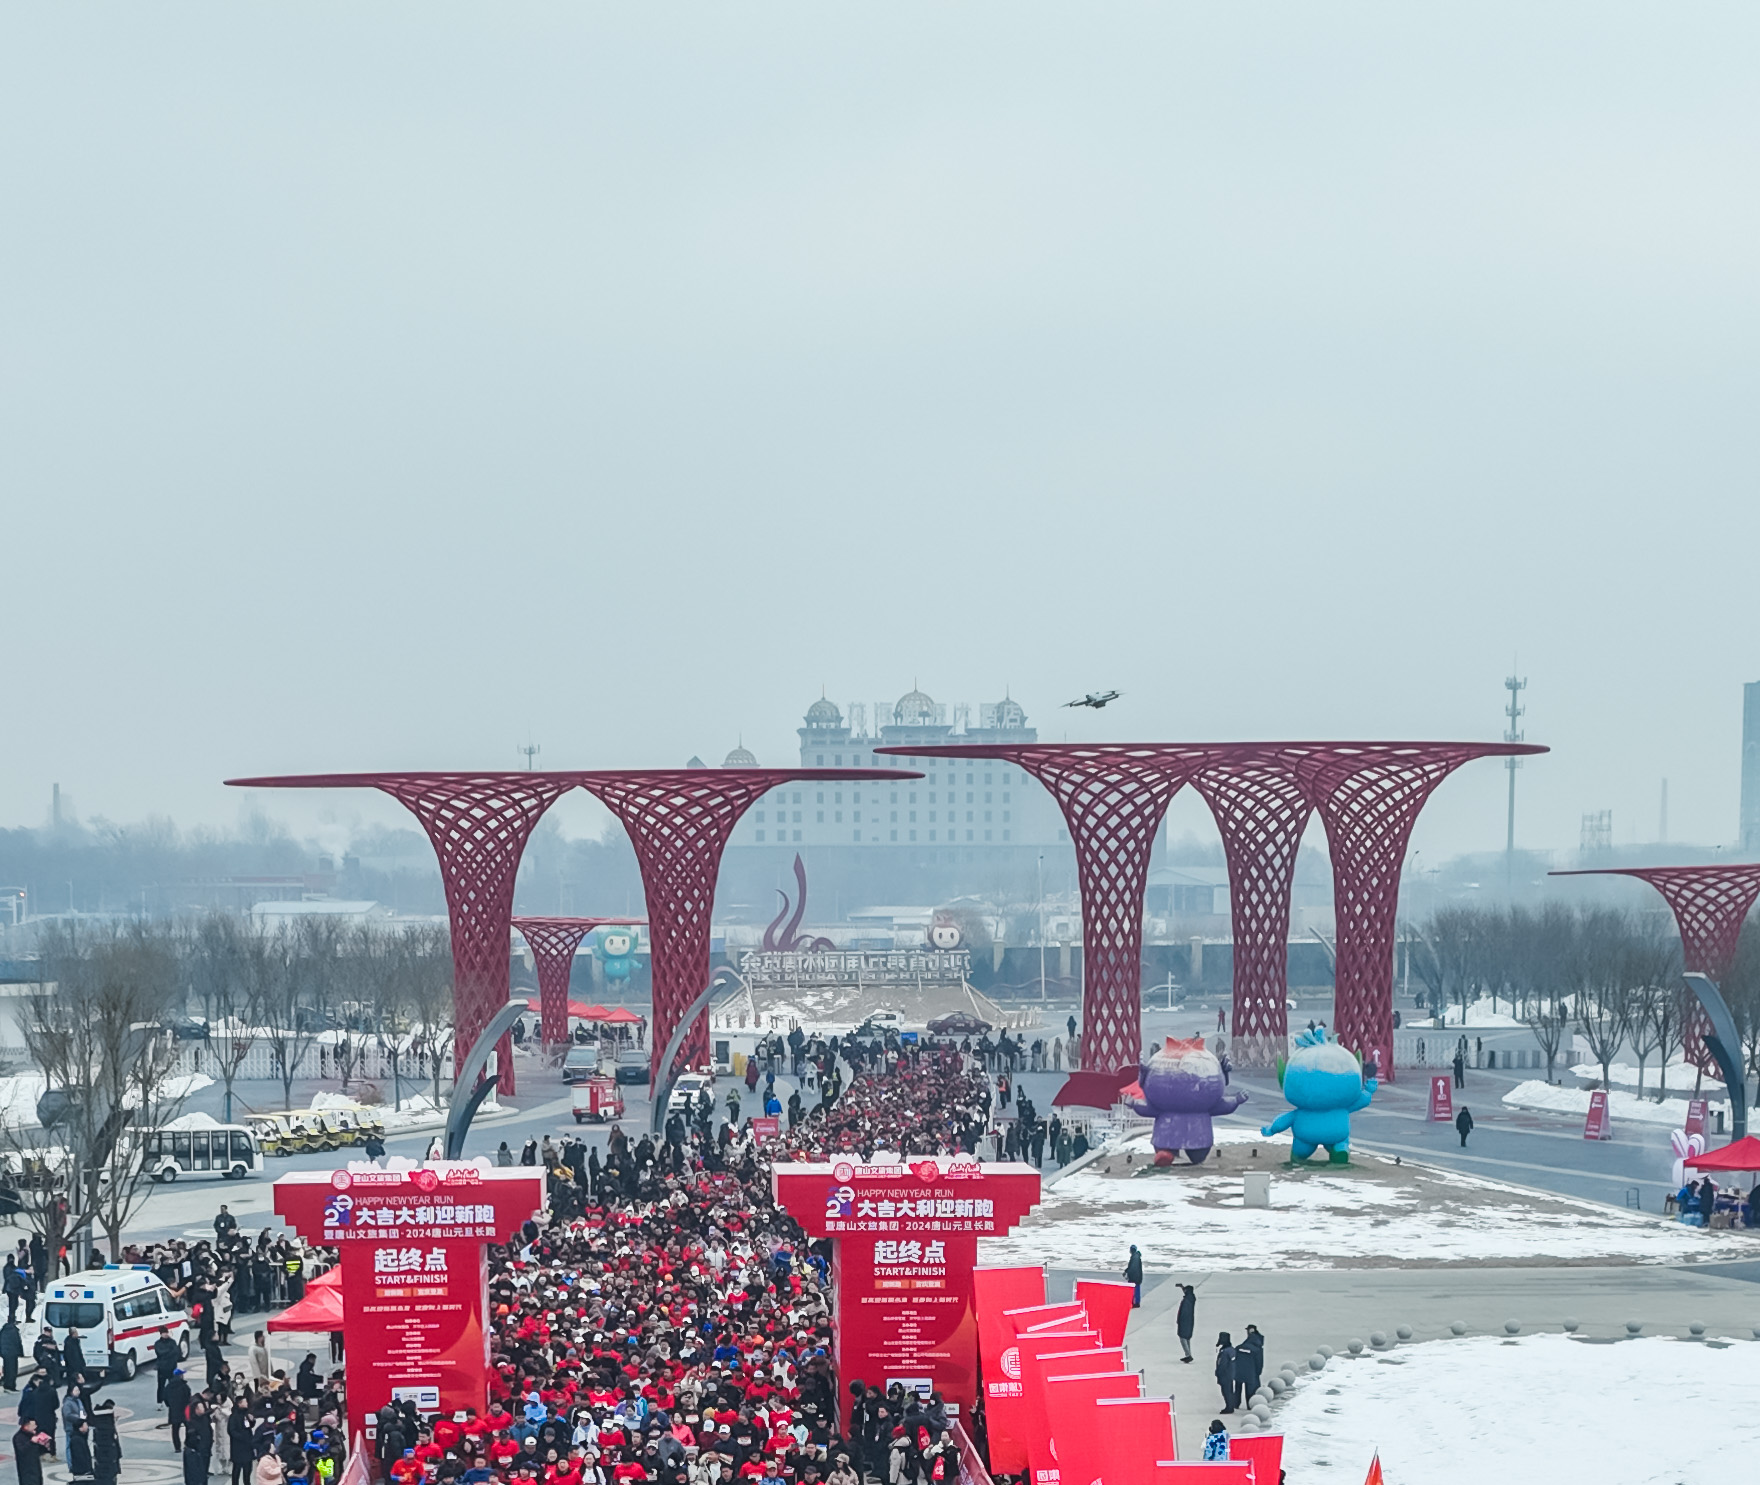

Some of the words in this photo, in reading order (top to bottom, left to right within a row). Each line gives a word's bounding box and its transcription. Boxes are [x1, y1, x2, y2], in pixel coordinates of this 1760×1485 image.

[356, 1205, 495, 1226] 大吉大利迎新跑
[857, 1199, 994, 1218] 大吉大利迎新跑
[374, 1248, 448, 1273] 起终点
[874, 1240, 947, 1264] 起终点
[375, 1274, 448, 1285] START&FINISH
[874, 1267, 946, 1276] START&FINISH
